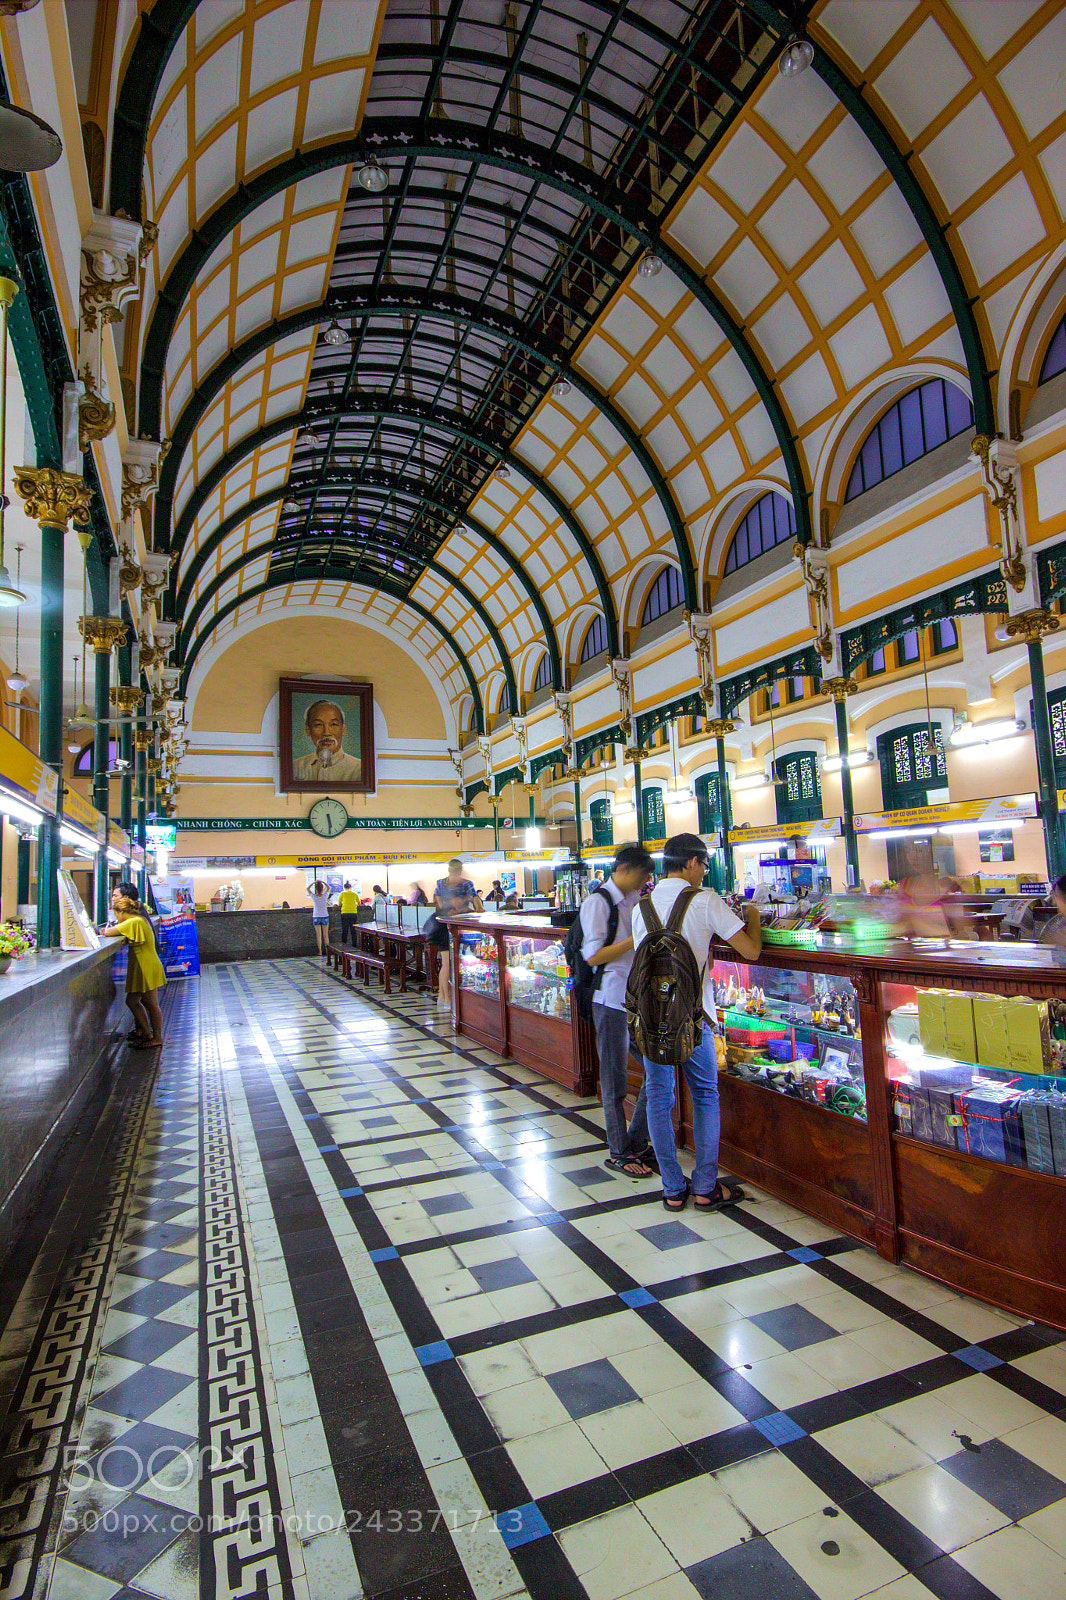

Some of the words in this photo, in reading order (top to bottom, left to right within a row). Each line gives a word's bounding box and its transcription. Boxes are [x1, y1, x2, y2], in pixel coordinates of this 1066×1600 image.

[177, 820, 209, 828] NHANH
[211, 819, 242, 828] CHÓNG
[252, 819, 281, 828] CHÍNH
[284, 819, 303, 828] XÁC
[367, 818, 387, 827] TOÀN
[392, 818, 409, 828] TIỆN
[410, 818, 423, 828] LỢI
[354, 853, 376, 861] PHẨM
